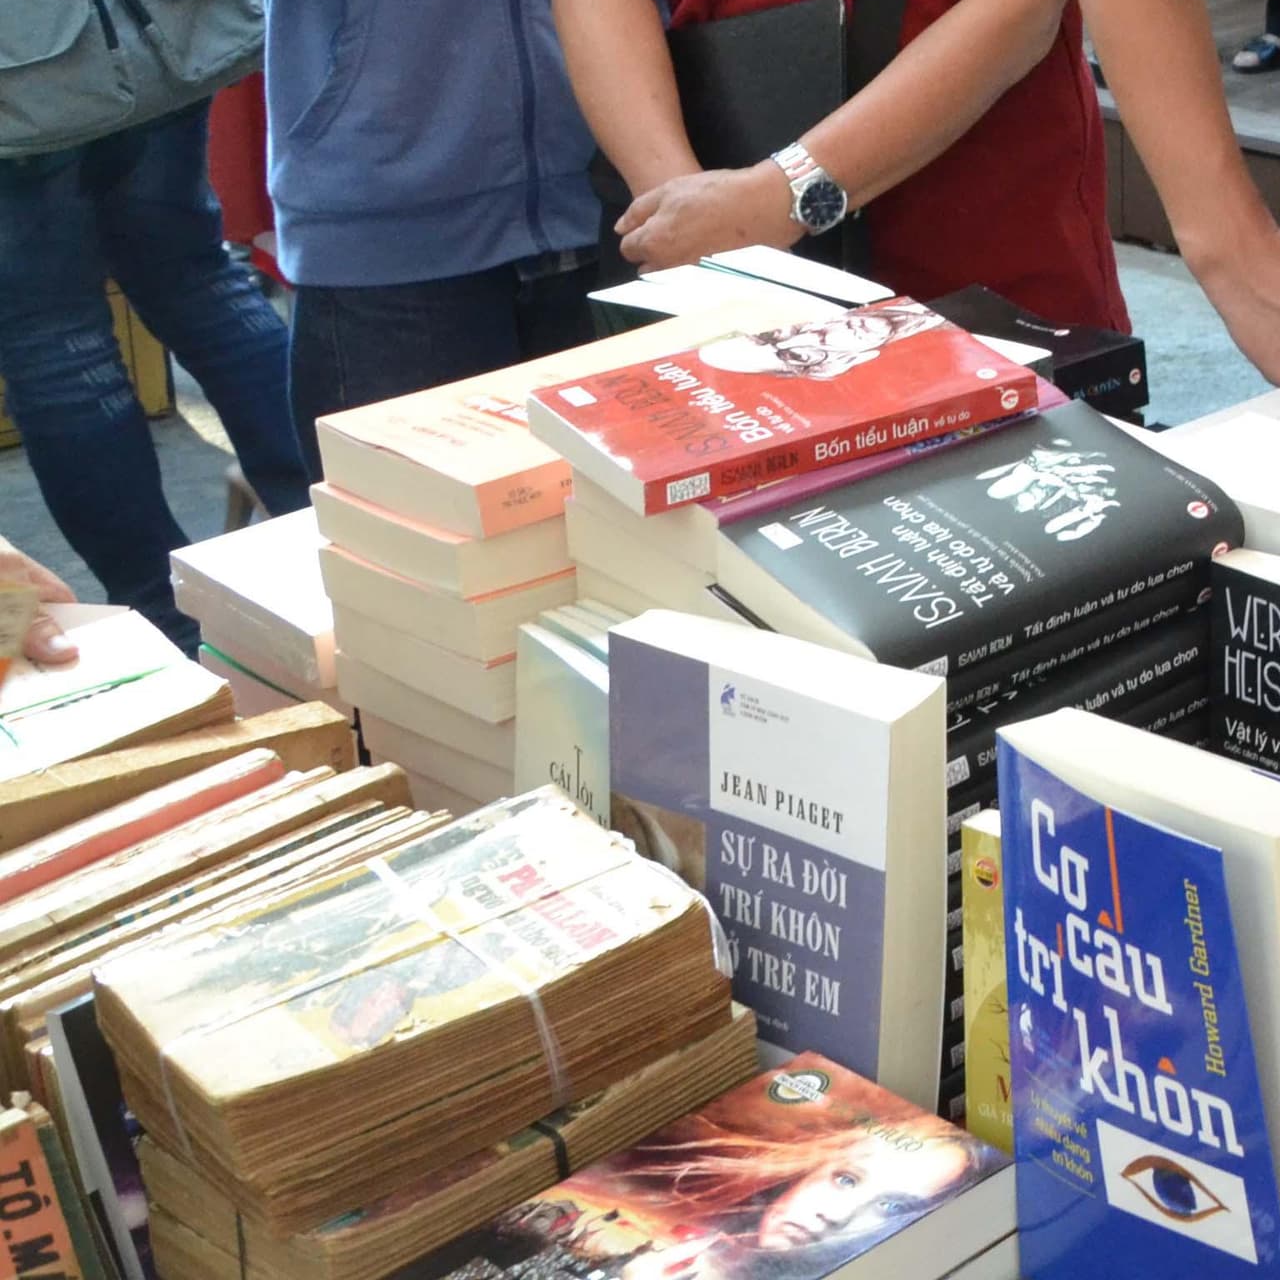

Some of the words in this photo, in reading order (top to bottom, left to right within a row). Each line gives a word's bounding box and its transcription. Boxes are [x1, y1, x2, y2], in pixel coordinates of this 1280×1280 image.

[814, 434, 851, 462] Bốn
[856, 423, 888, 450] tiểu
[892, 417, 930, 441] luận
[948, 537, 975, 559] do
[1024, 619, 1045, 640] Tất
[1046, 608, 1072, 631] định
[1073, 597, 1099, 619] luận
[1100, 591, 1115, 605] và
[1130, 578, 1146, 595] do
[1166, 560, 1194, 582] chọn
[1139, 667, 1154, 684] do
[1172, 645, 1199, 671] chọn
[1224, 716, 1251, 746] Vật
[1255, 727, 1268, 753] lý
[720, 771, 768, 807] JEAN
[775, 788, 844, 835] PIAGET
[720, 829, 756, 878] SỰ
[762, 843, 796, 890] RA
[801, 859, 849, 910] ĐỜI
[719, 882, 765, 930] TRÍ
[769, 900, 842, 963] KHÔN
[1065, 870, 1174, 1017] cấu
[1183, 877, 1210, 977] Gardner
[747, 945, 797, 998] TRẺ
[803, 968, 842, 1017] EM
[1193, 981, 1227, 1077] Howard
[1072, 1005, 1245, 1158] khôn
